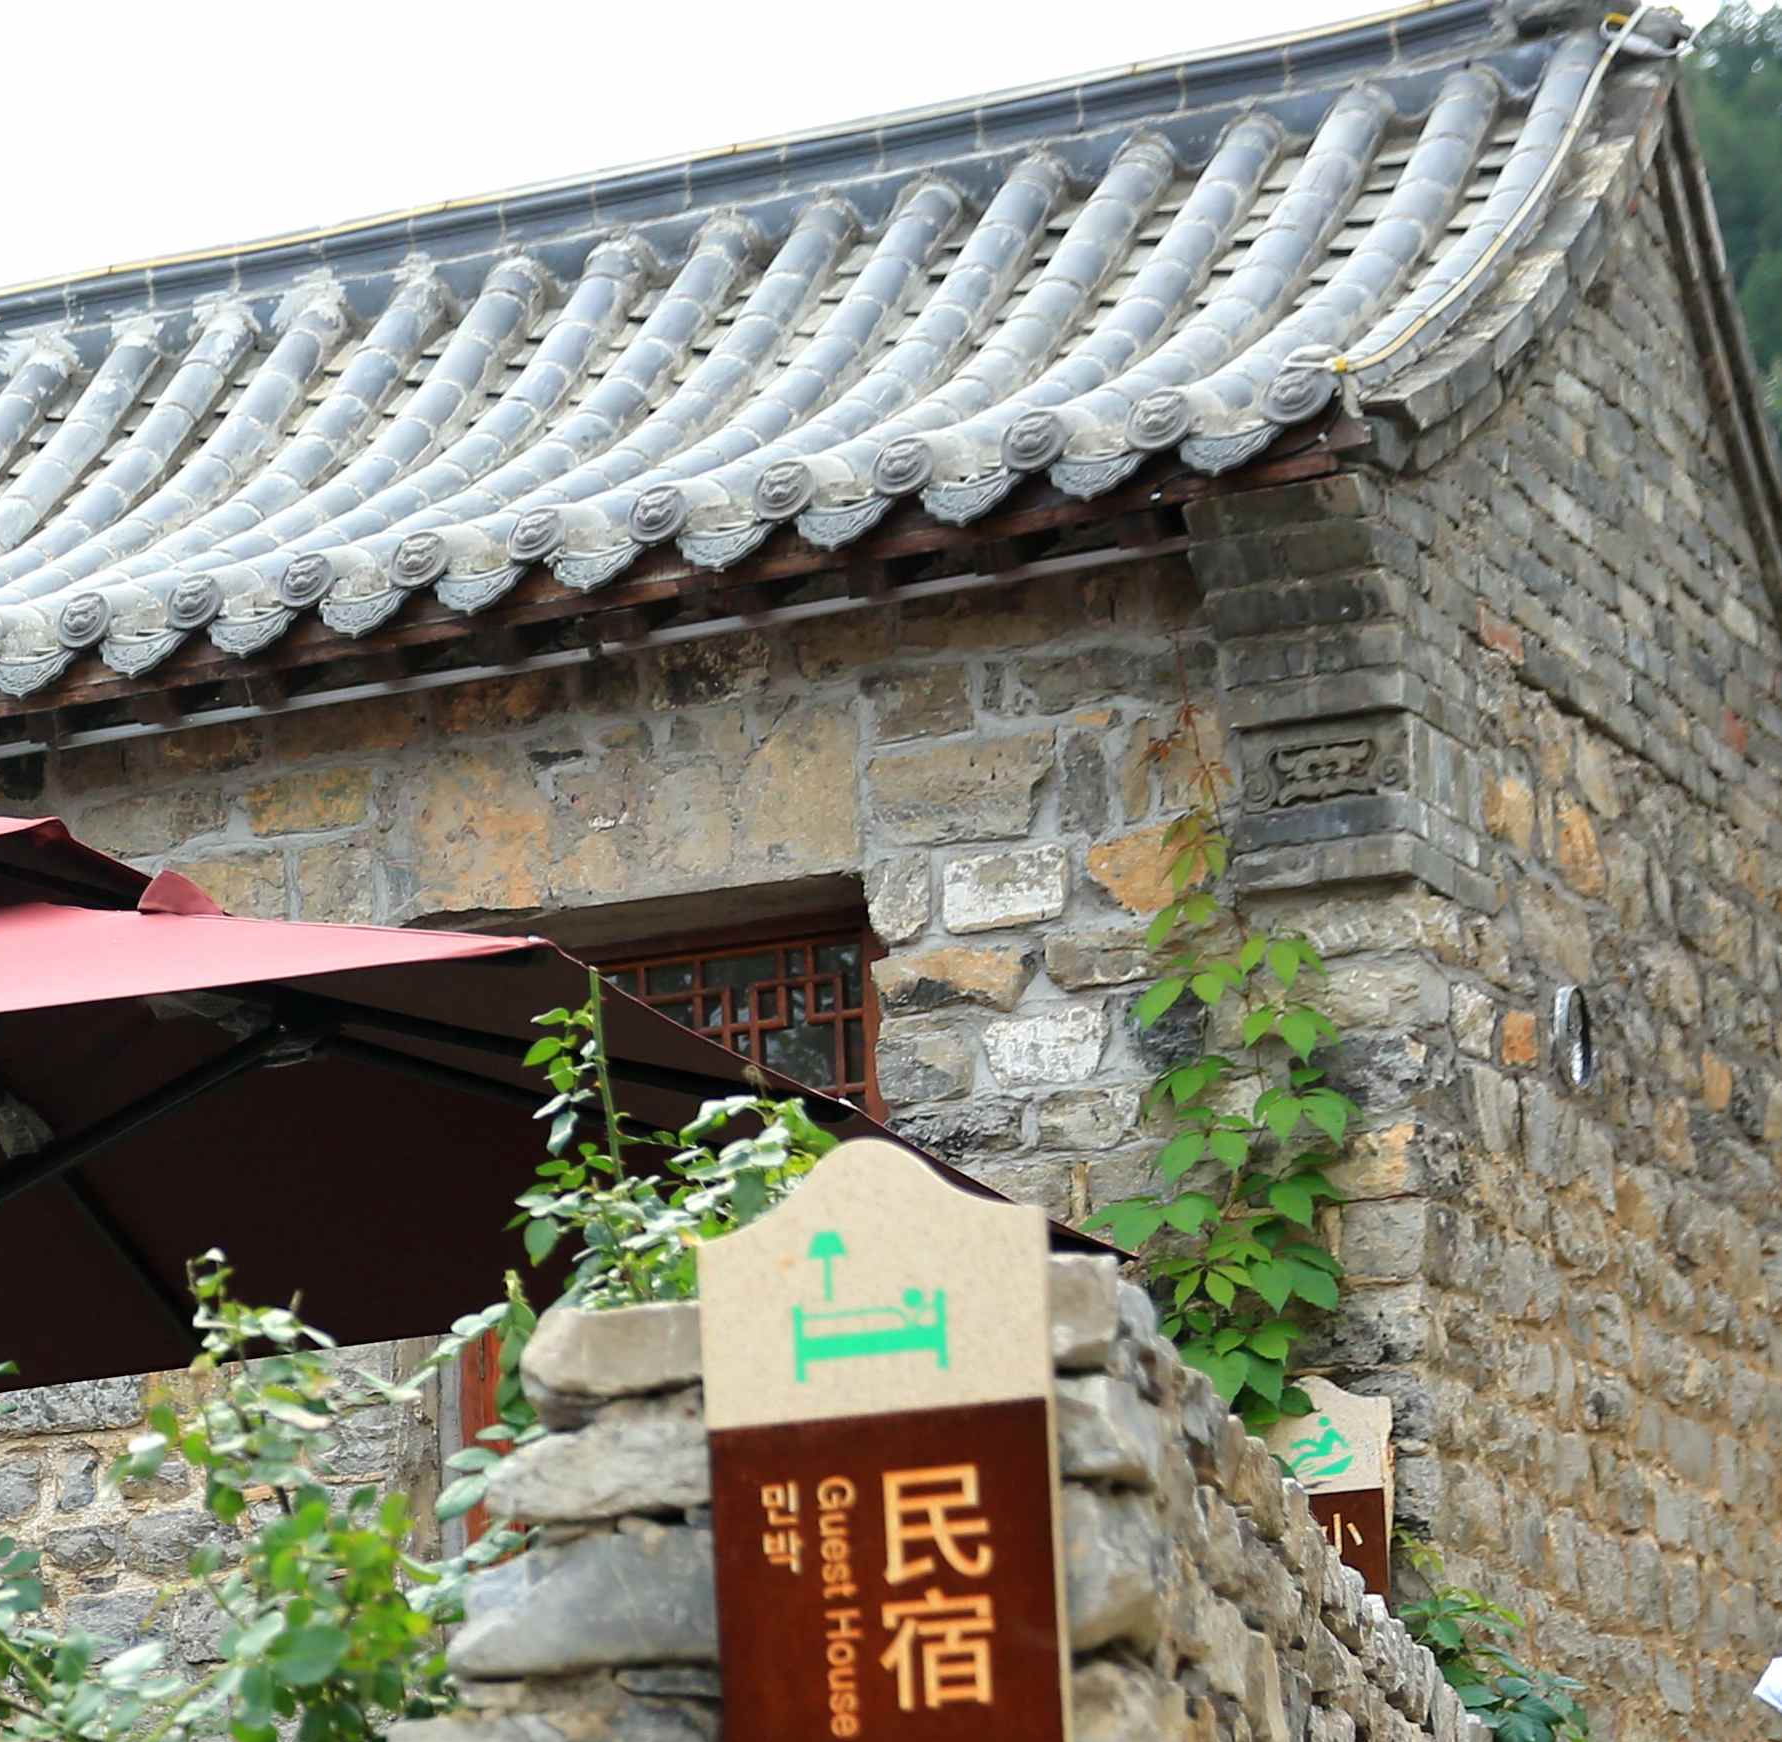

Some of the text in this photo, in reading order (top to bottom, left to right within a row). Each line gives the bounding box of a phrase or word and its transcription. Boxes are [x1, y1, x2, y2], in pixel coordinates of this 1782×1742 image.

[817, 1475, 864, 1739] Guest House
[879, 1463, 995, 1712] 民宿
